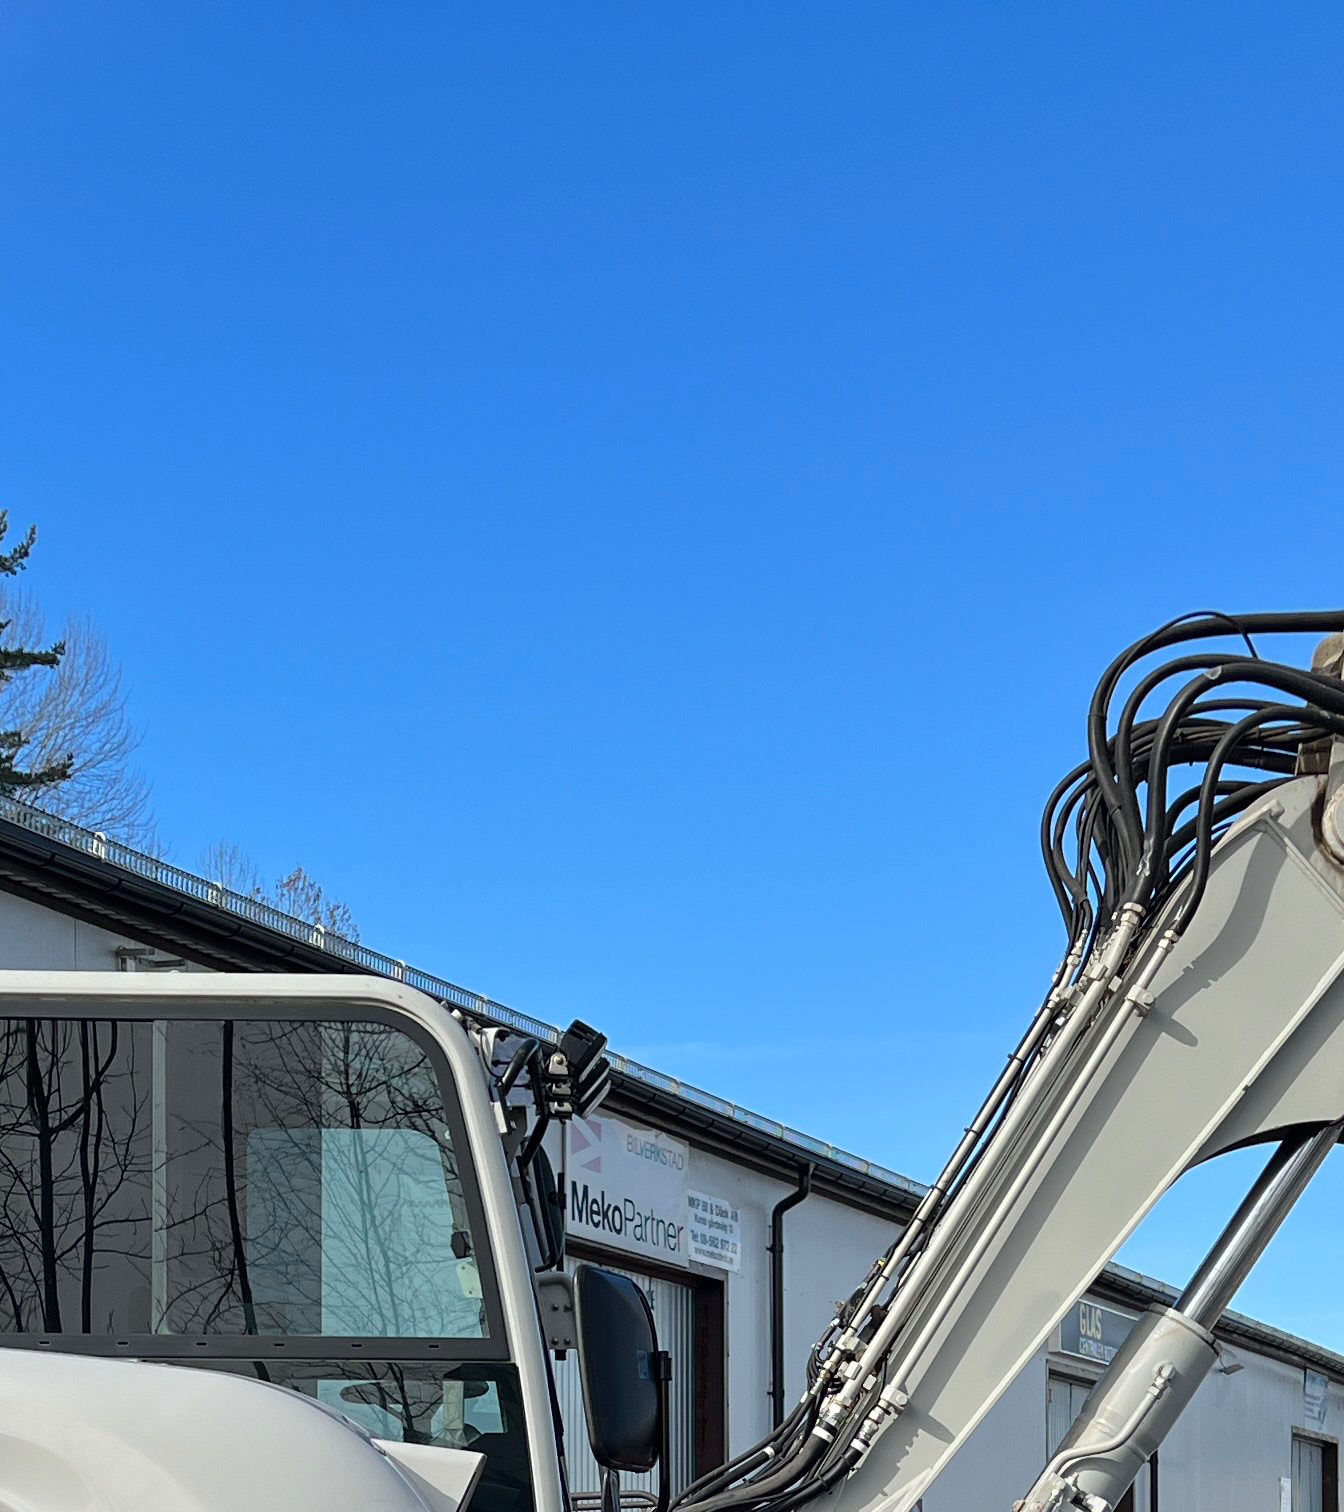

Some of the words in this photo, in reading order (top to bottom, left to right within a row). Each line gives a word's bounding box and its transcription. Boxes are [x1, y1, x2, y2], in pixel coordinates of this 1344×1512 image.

[626, 1134, 684, 1170] BILVERKSTAD
[571, 1180, 684, 1252] MekoPartner
[1079, 1303, 1102, 1340] GLAS
